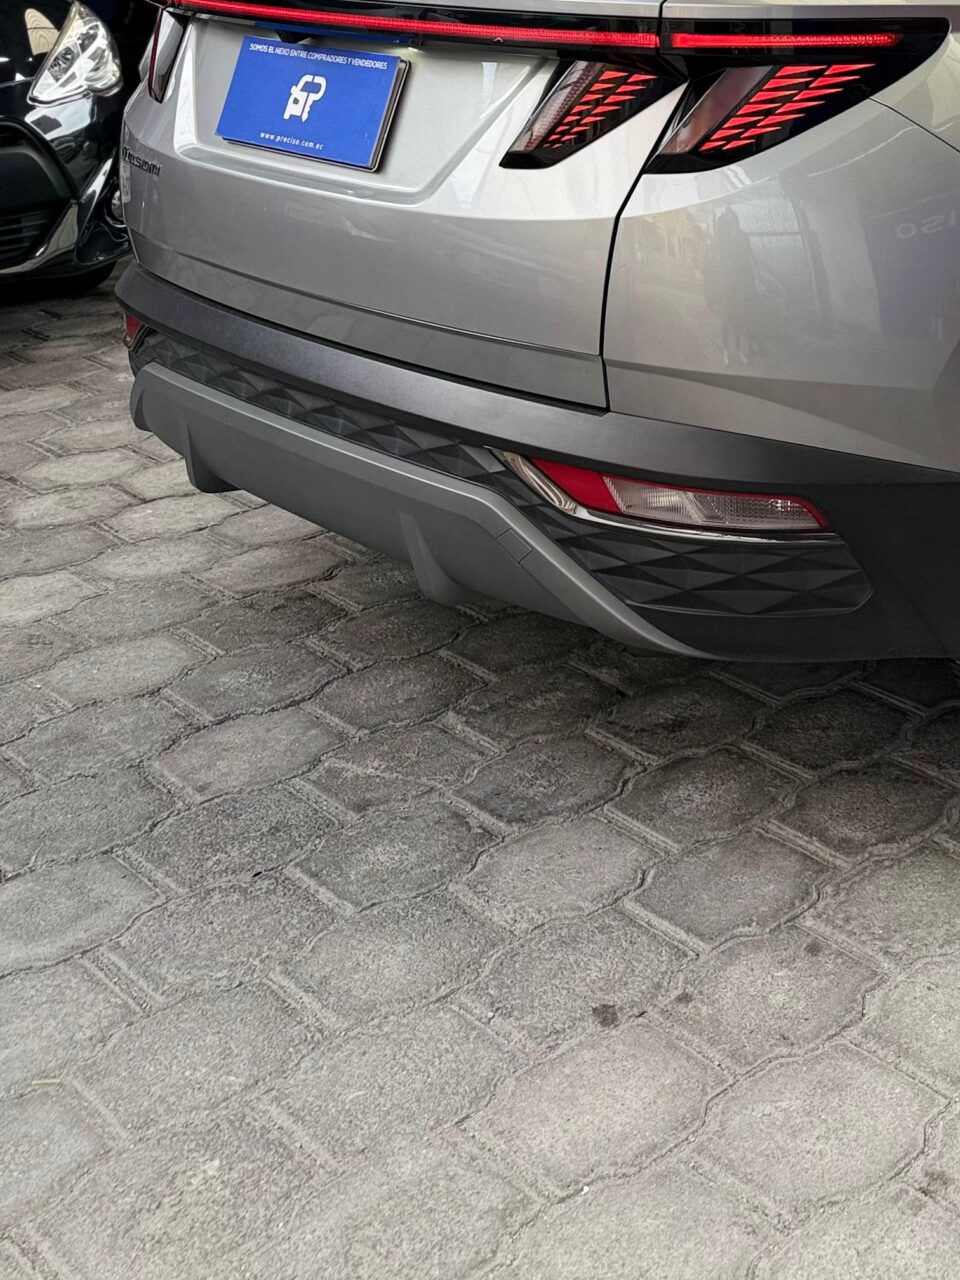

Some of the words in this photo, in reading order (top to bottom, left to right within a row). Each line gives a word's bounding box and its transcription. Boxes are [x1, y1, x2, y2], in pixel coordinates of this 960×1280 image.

[249, 42, 268, 53] SOMOS
[268, 45, 275, 54] EL
[275, 47, 289, 56] NEXO
[290, 49, 308, 58] ENTRE
[308, 51, 347, 65] COMPRADORES
[351, 57, 388, 70] VENDEDORES
[260, 132, 324, 151] www.preciso.com.ec
